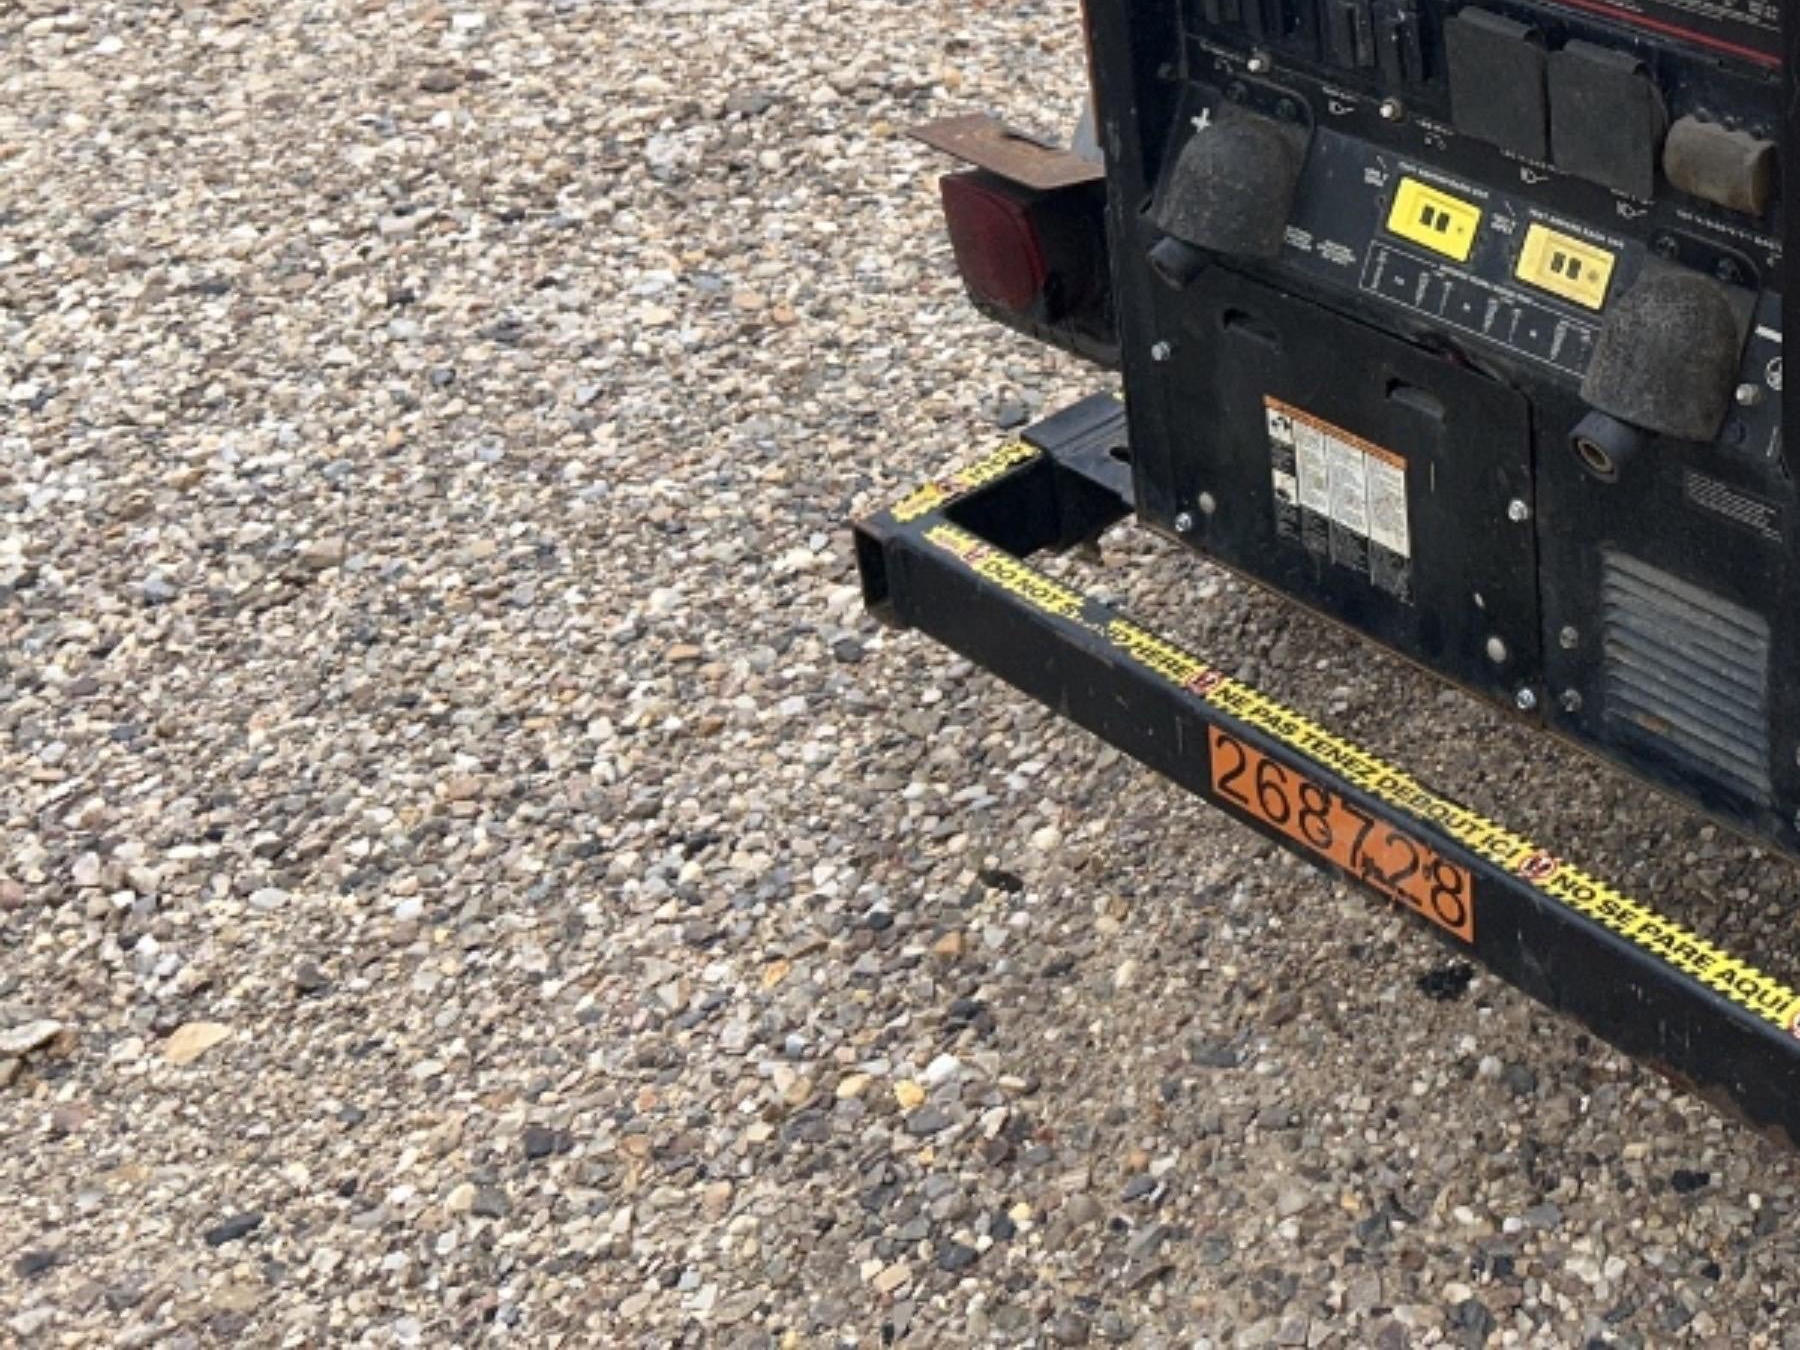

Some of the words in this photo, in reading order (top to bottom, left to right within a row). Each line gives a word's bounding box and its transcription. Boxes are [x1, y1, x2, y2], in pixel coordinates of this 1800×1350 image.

[1213, 685, 1246, 710] NE
[1248, 704, 1300, 739] PAS
[1299, 730, 1376, 779] TENEZ
[1551, 872, 1597, 902] NO
[1596, 899, 1638, 927] SE
[1637, 922, 1717, 972] PARE
[1714, 967, 1792, 1016] AQUI
[1216, 734, 1466, 929] 268728
